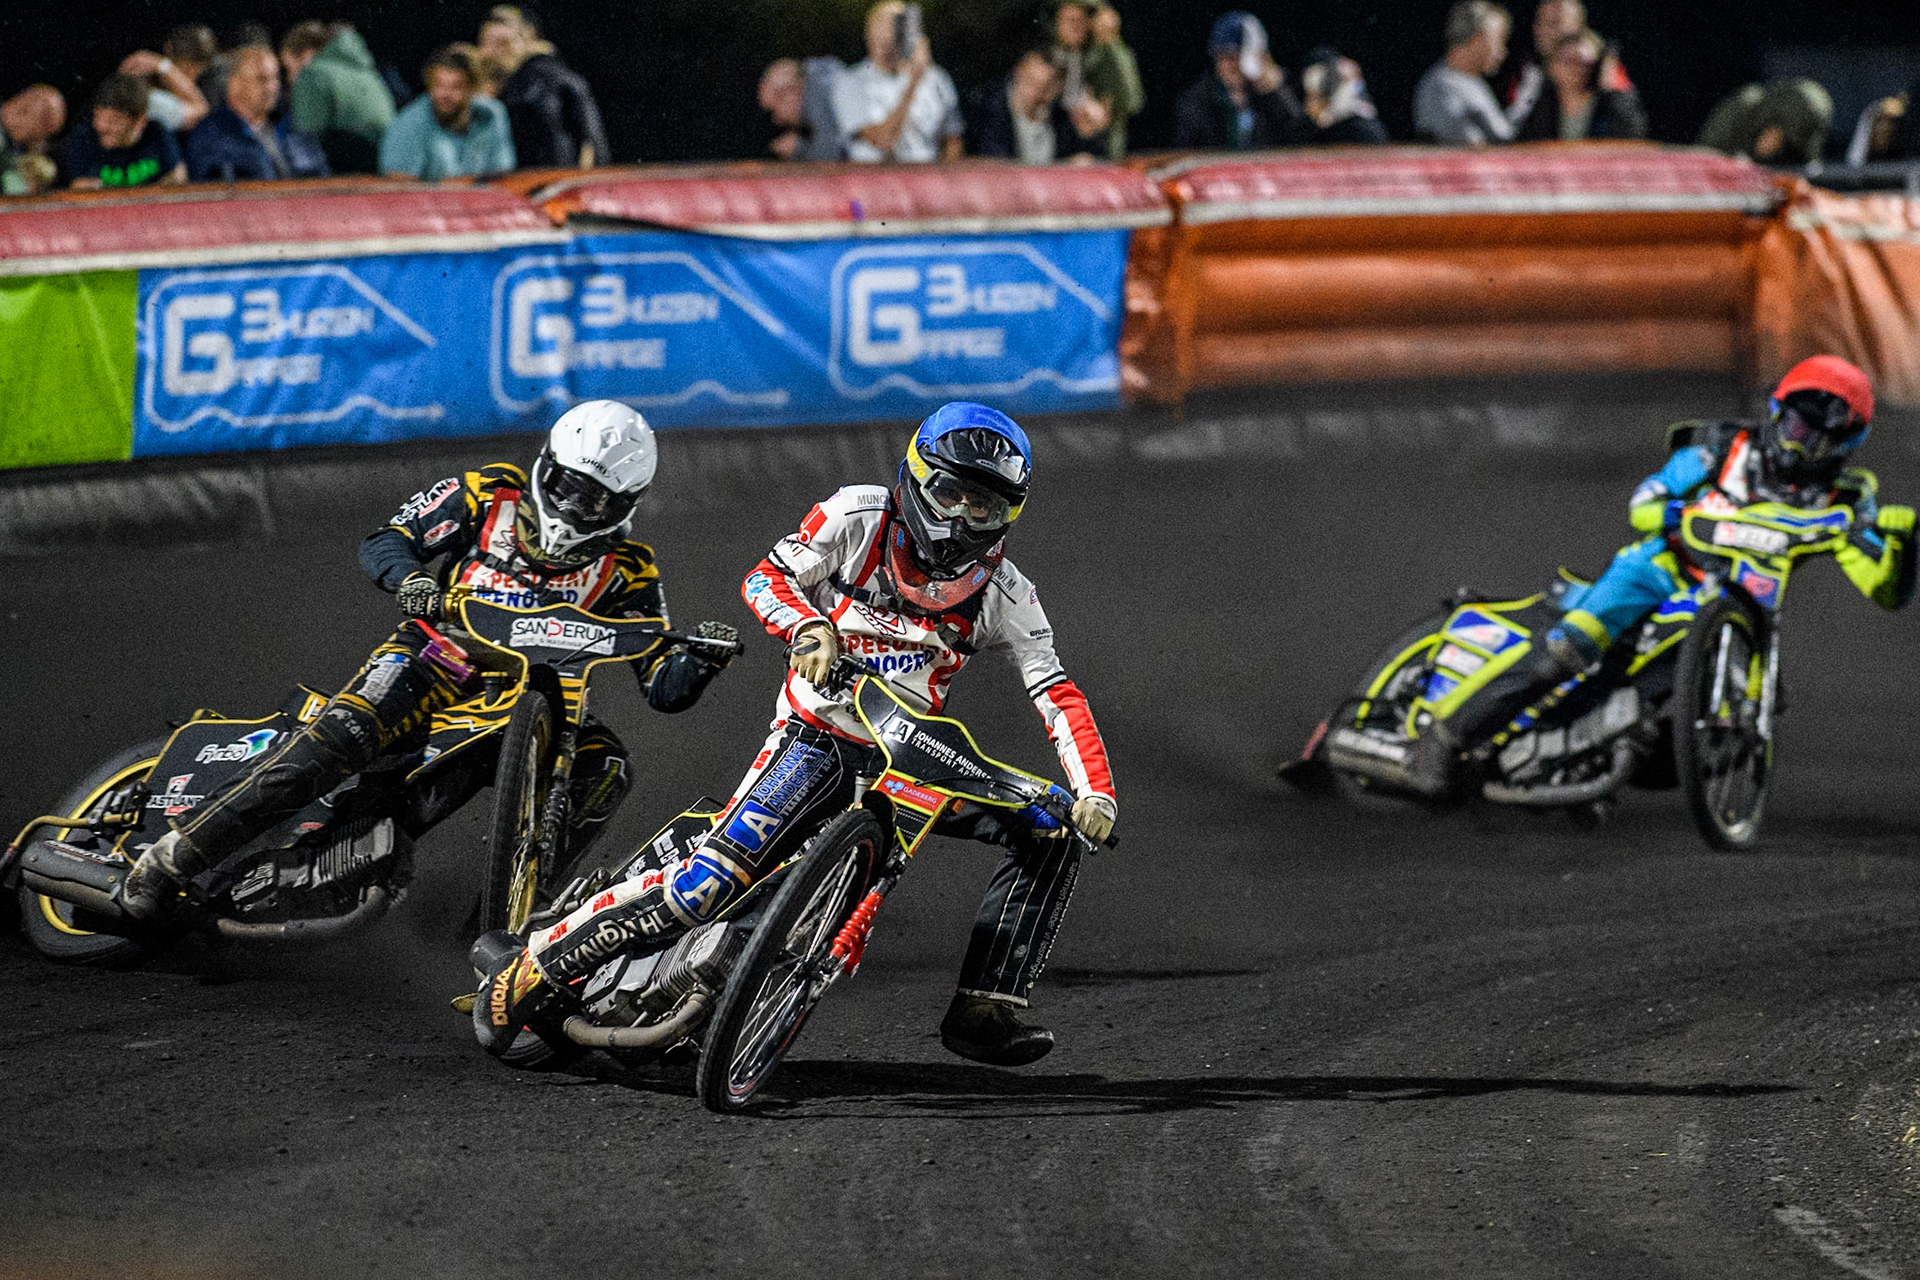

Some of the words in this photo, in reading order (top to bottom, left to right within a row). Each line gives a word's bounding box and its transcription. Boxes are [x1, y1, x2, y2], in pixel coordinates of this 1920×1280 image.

[510, 619, 613, 645] SANDERUM
[911, 738, 957, 769] TRANSPORT
[913, 730, 957, 760] JOHANNES
[752, 740, 811, 802] JOHANNES
[767, 747, 828, 812] ANDERSEN
[903, 786, 938, 804] GADEBERG
